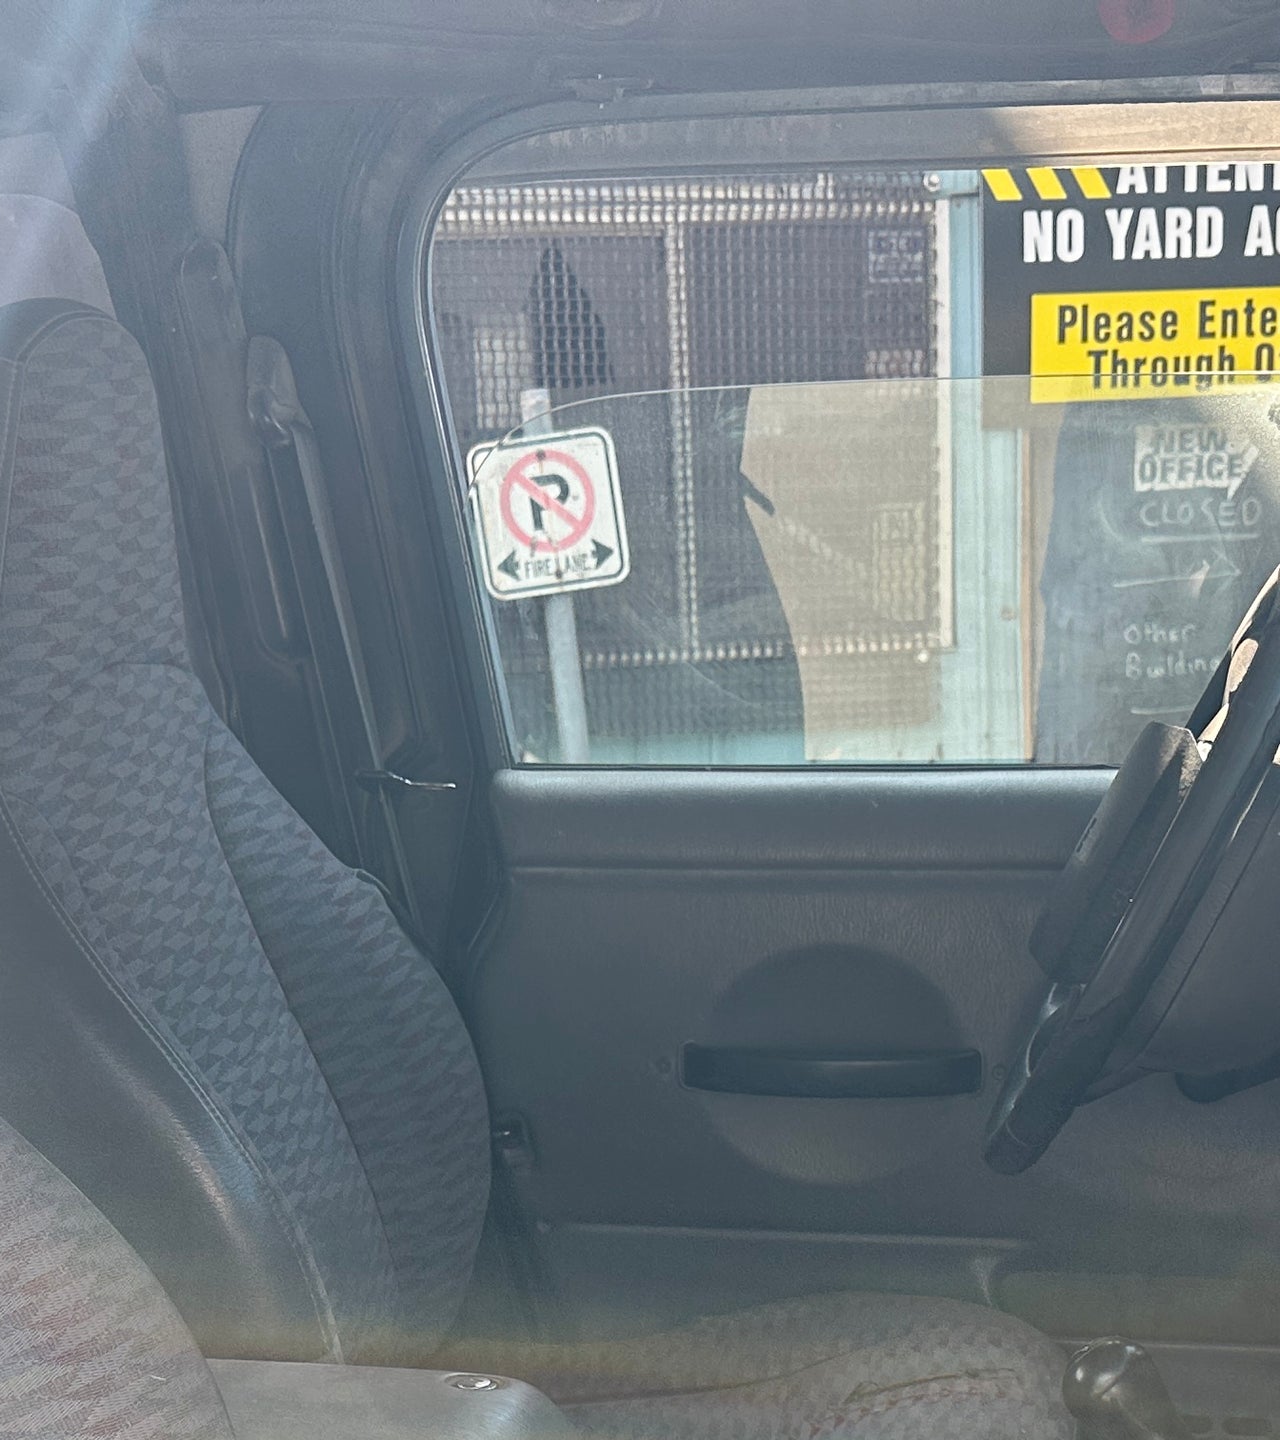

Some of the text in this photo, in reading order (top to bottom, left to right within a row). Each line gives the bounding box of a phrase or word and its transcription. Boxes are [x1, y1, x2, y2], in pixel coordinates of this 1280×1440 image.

[1022, 208, 1085, 263] NO
[1106, 204, 1224, 261] YARD
[1057, 304, 1178, 344] Please
[1087, 346, 1235, 391] Through
[1140, 452, 1243, 484] OFFICE
[1140, 498, 1261, 527] CLOSED
[524, 559, 555, 580] FIRE
[1123, 621, 1196, 645] Other
